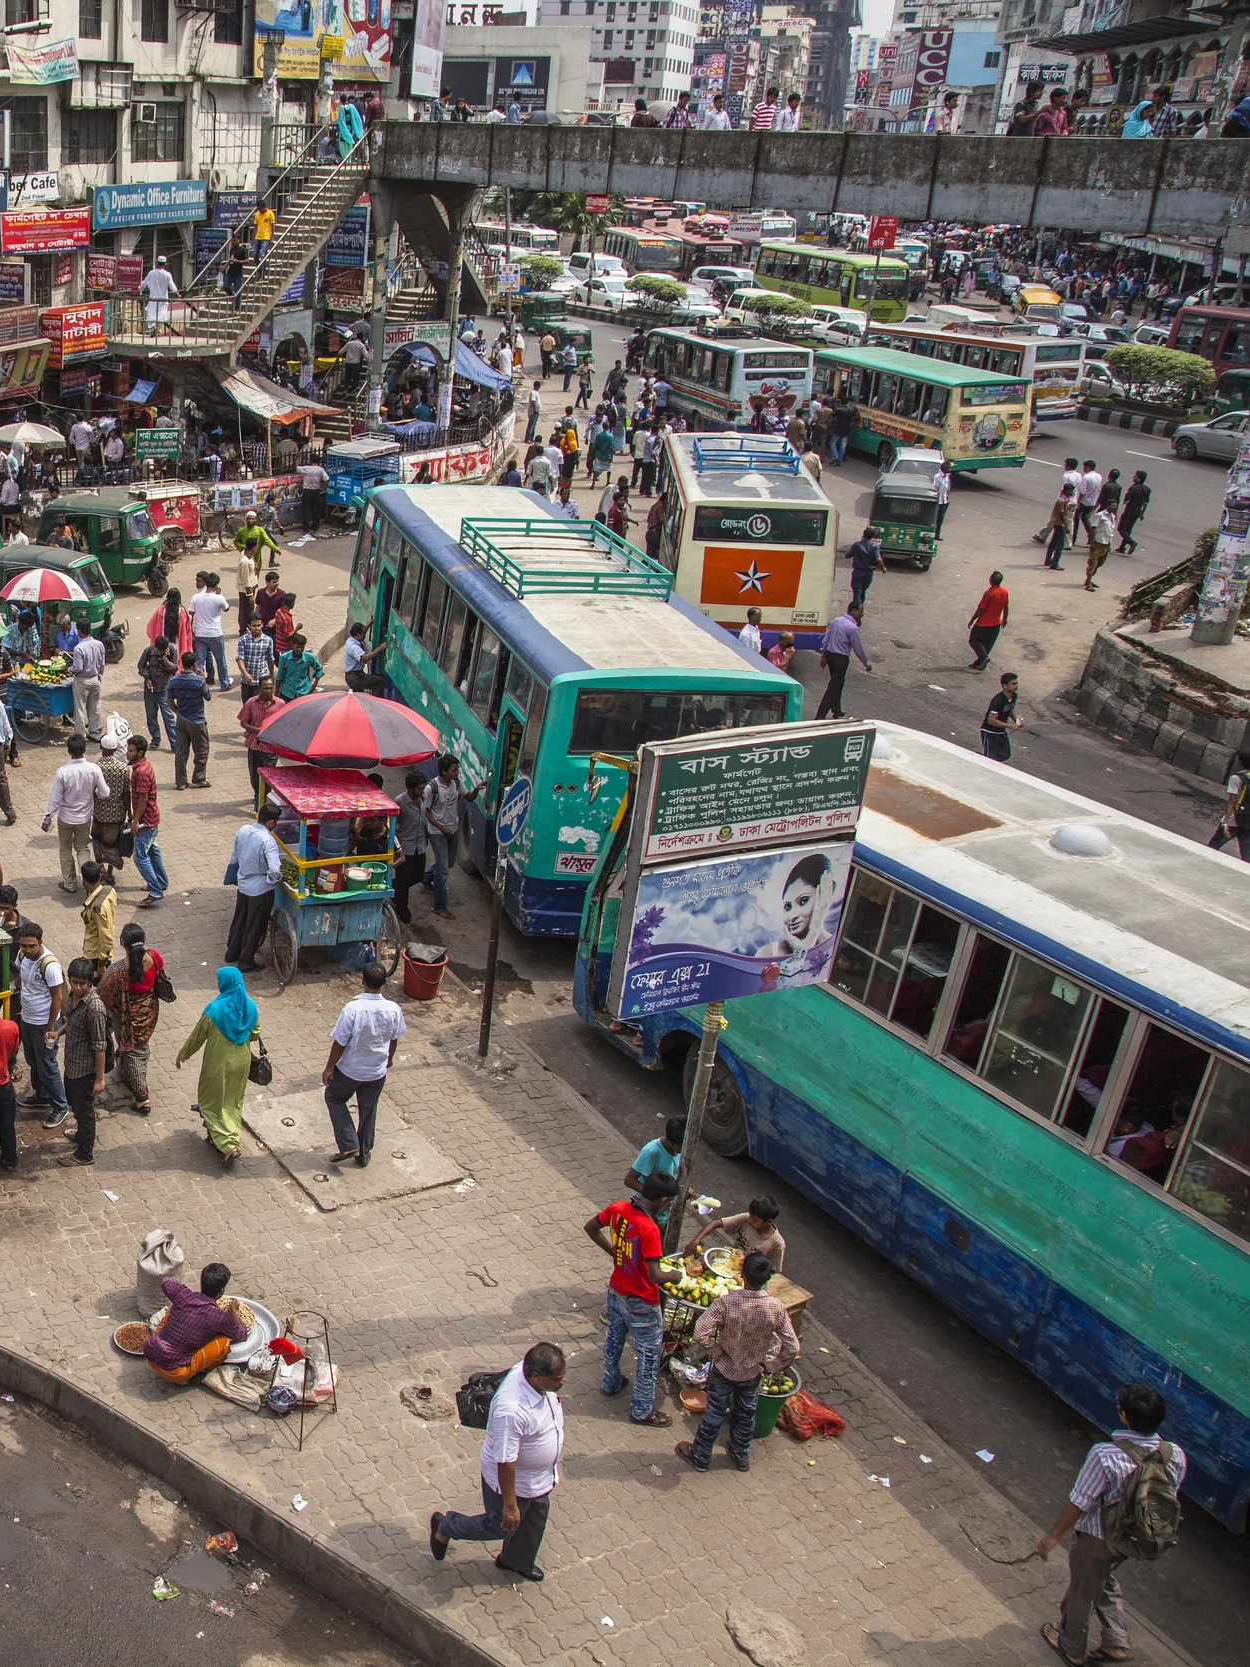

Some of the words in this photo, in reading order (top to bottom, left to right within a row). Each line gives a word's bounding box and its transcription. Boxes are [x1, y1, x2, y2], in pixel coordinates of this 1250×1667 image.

[777, 20, 803, 28] omec
[916, 30, 953, 86] UCC
[1020, 66, 1041, 82] কাজী
[1041, 66, 1067, 83] অফিস
[30, 176, 56, 194] Cafe
[111, 188, 146, 214] Dynamic
[147, 186, 170, 206] Office
[171, 185, 204, 205] Furniture
[64, 210, 89, 221] চেম্বার
[111, 214, 135, 223] FOREIGN
[136, 211, 167, 220] FURNITURE
[168, 209, 184, 218] SALES
[185, 208, 205, 216] CENTRE
[6, 241, 35, 251] অনুবাদ
[47, 238, 75, 249] নোটারী
[872, 238, 885, 247] রবি
[89, 259, 115, 270] নোটারী
[89, 267, 114, 277] অনুবাদ
[42, 319, 62, 330] অনুবাদ
[385, 327, 415, 344] সামিট
[848, 743, 861, 751] BUS
[677, 755, 731, 775] বাস
[738, 745, 814, 764] স্ট্যান্ড
[669, 786, 698, 797] বাসের
[701, 783, 717, 793] রুট
[720, 781, 743, 791] নম্বর,
[746, 776, 773, 787] রেজিঃ
[793, 770, 819, 780] গন্তব্য
[820, 767, 838, 776] স্থান
[840, 765, 860, 773] এবং
[723, 767, 763, 780] ফার্মগেট
[668, 793, 716, 805] পরিবহনের
[718, 790, 736, 799] নাম
[738, 785, 768, 796] যথাযথ
[771, 782, 793, 792] স্থানে
[795, 777, 824, 787] প্রদর্শন
[826, 775, 850, 783] করুন
[663, 813, 697, 824] ট্রাফিক
[699, 809, 727, 820] পুলিশ
[730, 803, 772, 814] সহায়তার
[775, 798, 795, 808] জন্য
[796, 794, 825, 804] ডায়াল
[665, 804, 697, 816] ট্রাফিক
[699, 800, 725, 810] আইন
[728, 796, 750, 805] মেনে
[753, 794, 774, 803] চলুন
[658, 833, 706, 850] নির্দেশক্রমে
[739, 824, 762, 838] ঢাকা
[764, 815, 823, 834] মেট্রোপলিটন
[825, 810, 852, 827] পুলিশ
[560, 856, 598, 873] থামুন
[692, 870, 715, 883] মানের
[716, 864, 742, 881] প্রতীক
[667, 966, 694, 986] এক্স
[695, 962, 711, 977] 21
